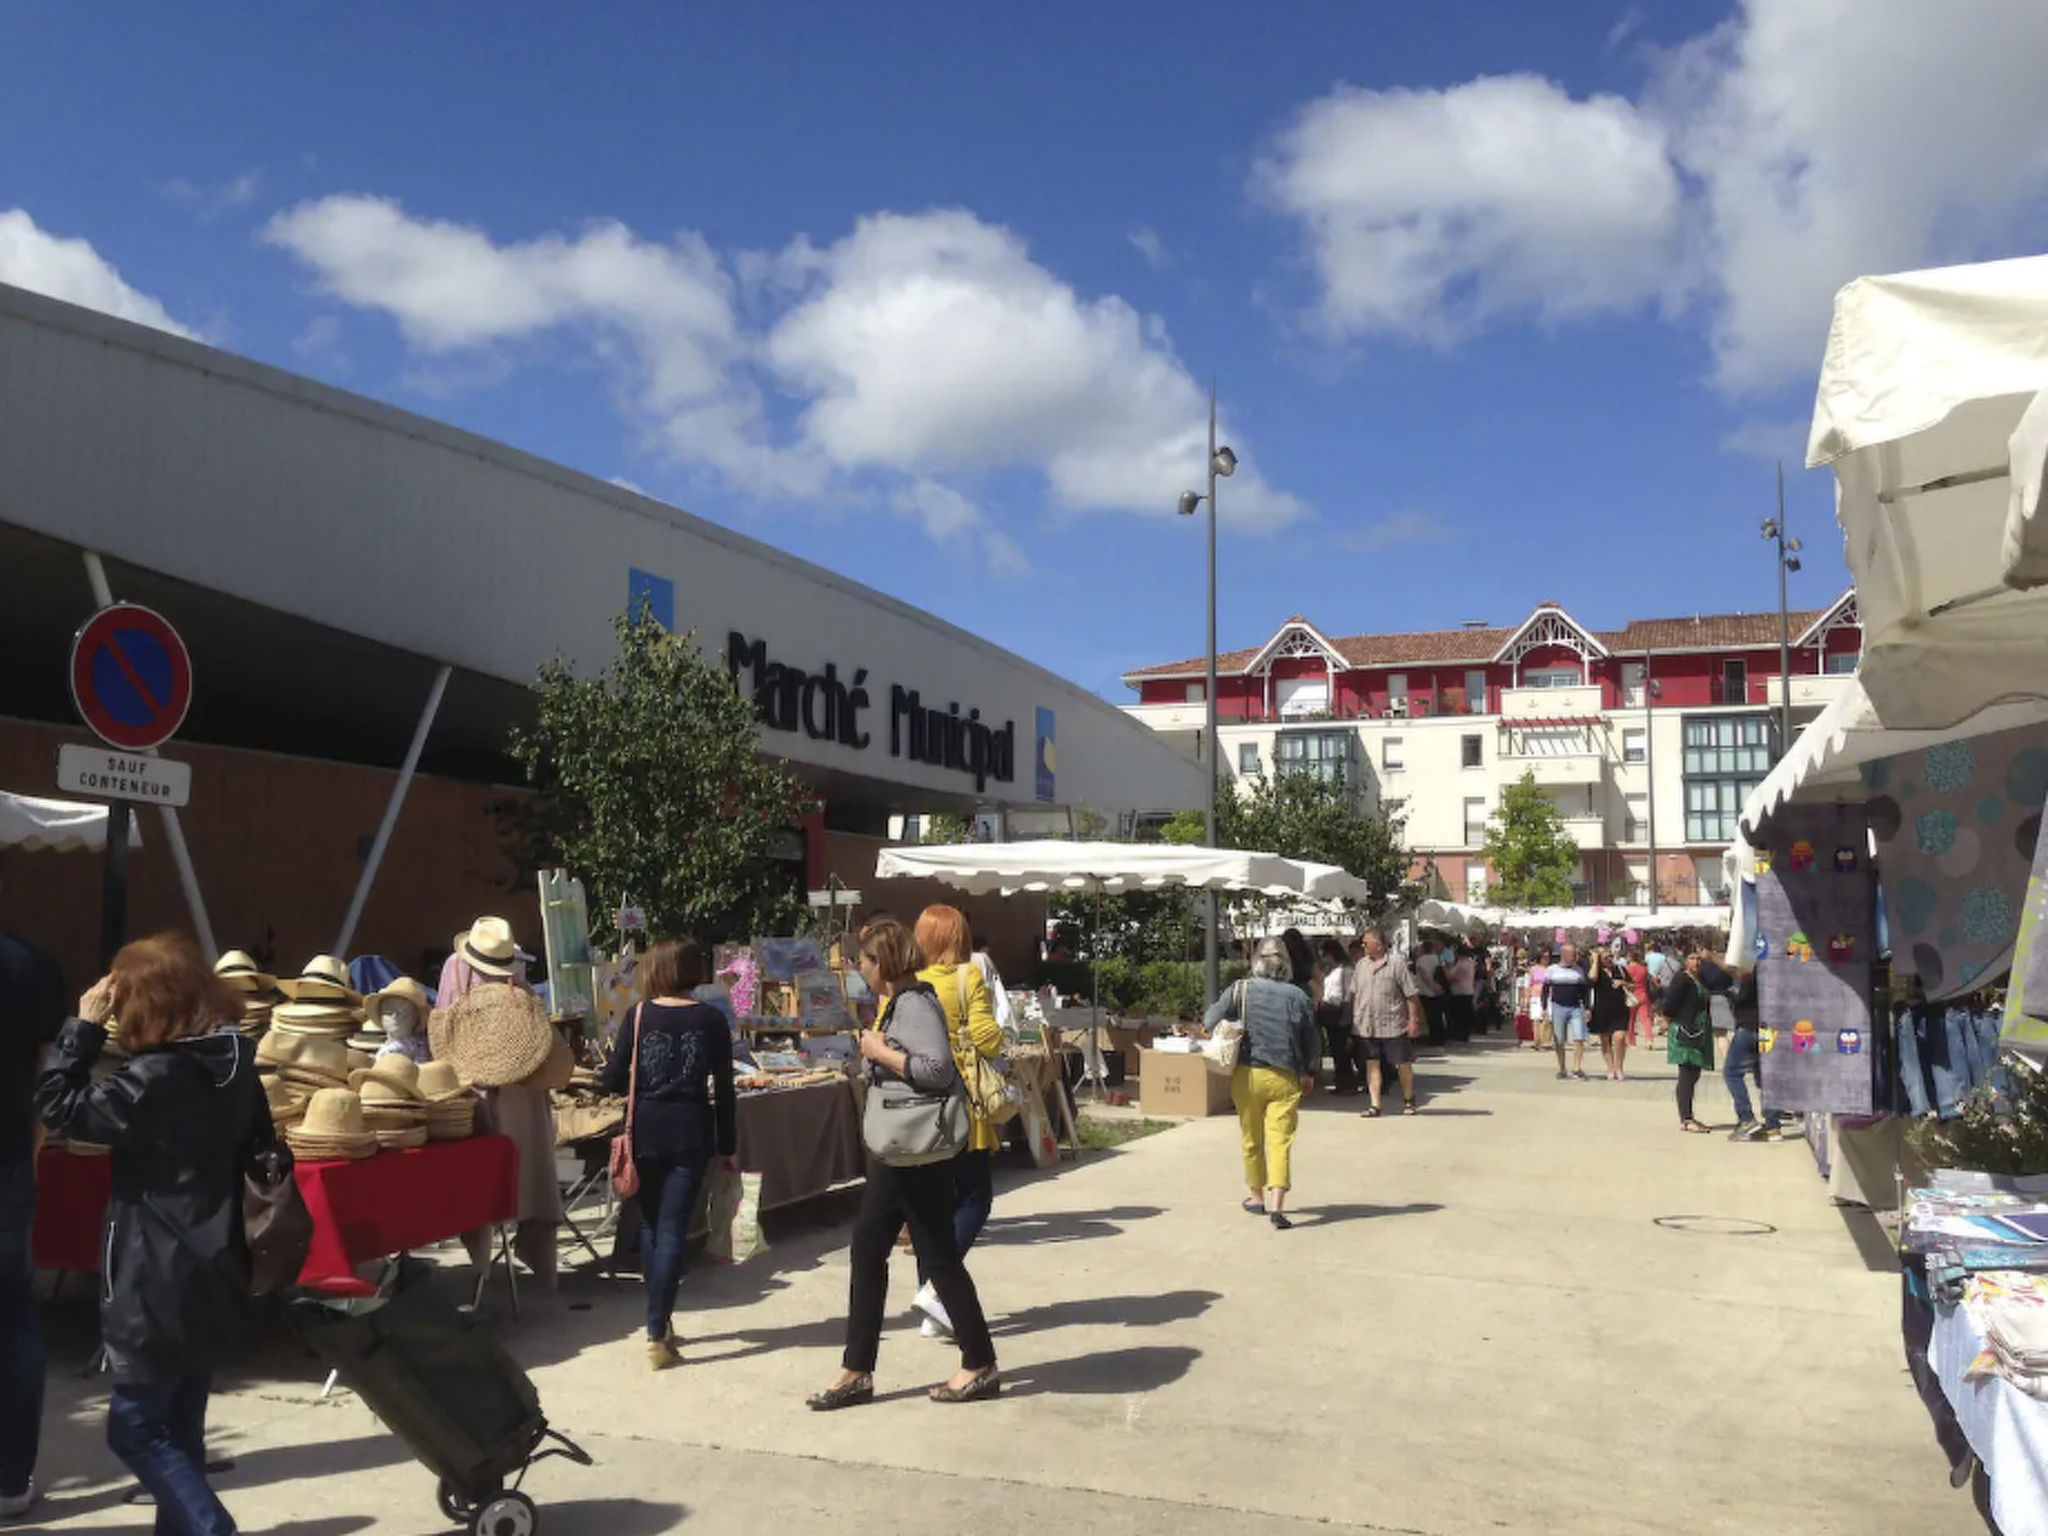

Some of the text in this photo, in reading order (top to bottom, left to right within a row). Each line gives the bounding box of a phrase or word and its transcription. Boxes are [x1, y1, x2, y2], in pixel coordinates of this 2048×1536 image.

[728, 631, 1014, 793] Marché Municipal
[108, 757, 147, 775] SAUF
[79, 772, 170, 797] CONTENEUR
